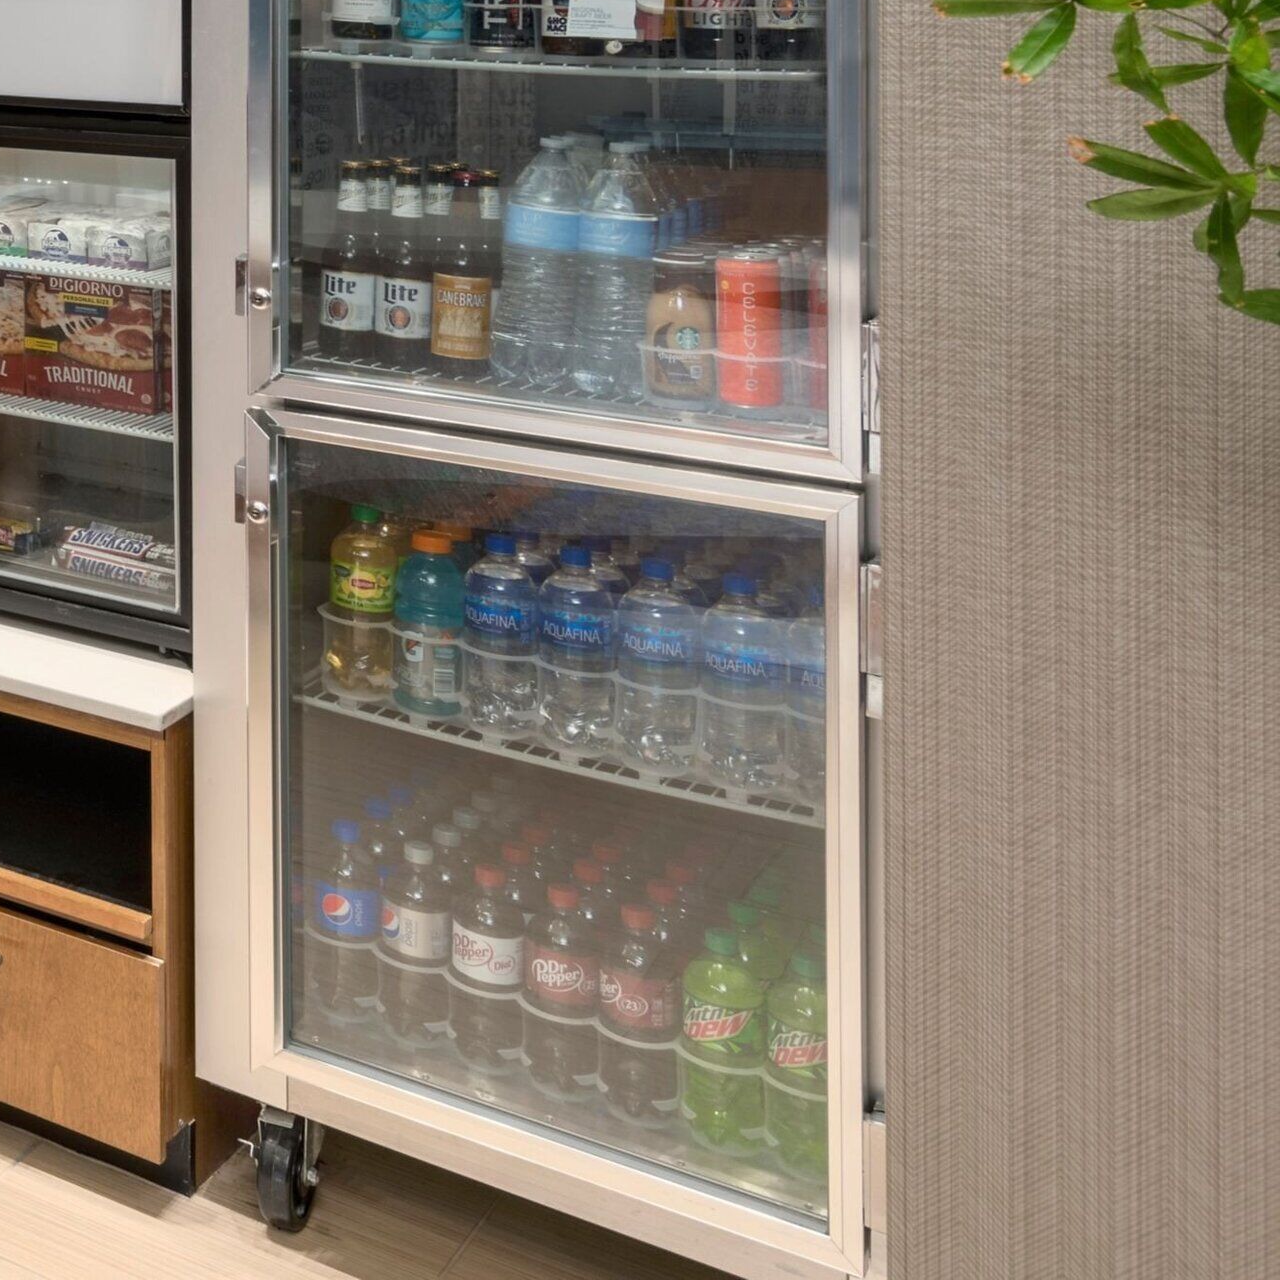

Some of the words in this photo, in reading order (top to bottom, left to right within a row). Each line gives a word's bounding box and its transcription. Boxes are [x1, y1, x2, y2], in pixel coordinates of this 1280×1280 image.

[692, 13, 744, 27] LIGHT
[48, 275, 124, 299] DIGIORNO
[323, 273, 358, 297] Lite
[383, 281, 420, 305] Lite
[61, 293, 95, 305] PERSONAL
[96, 296, 111, 306] SIZE
[436, 288, 488, 308] CANEBRAKE
[43, 365, 136, 396] TRADITIONAL
[74, 384, 103, 394] CRUST
[69, 526, 148, 555] SNICKERS
[68, 556, 143, 588] SNICKERS
[465, 604, 518, 632] AQUAFINA
[543, 620, 601, 645] AQUAFINA
[622, 631, 684, 659] AQUAFINA
[705, 651, 766, 677] AQUAFINA
[353, 898, 363, 927] pepsi
[452, 936, 490, 960] Pepper
[493, 959, 512, 971] Diet
[532, 960, 581, 985] Pepper
[547, 960, 569, 973] Dr
[623, 998, 638, 1012] 23
